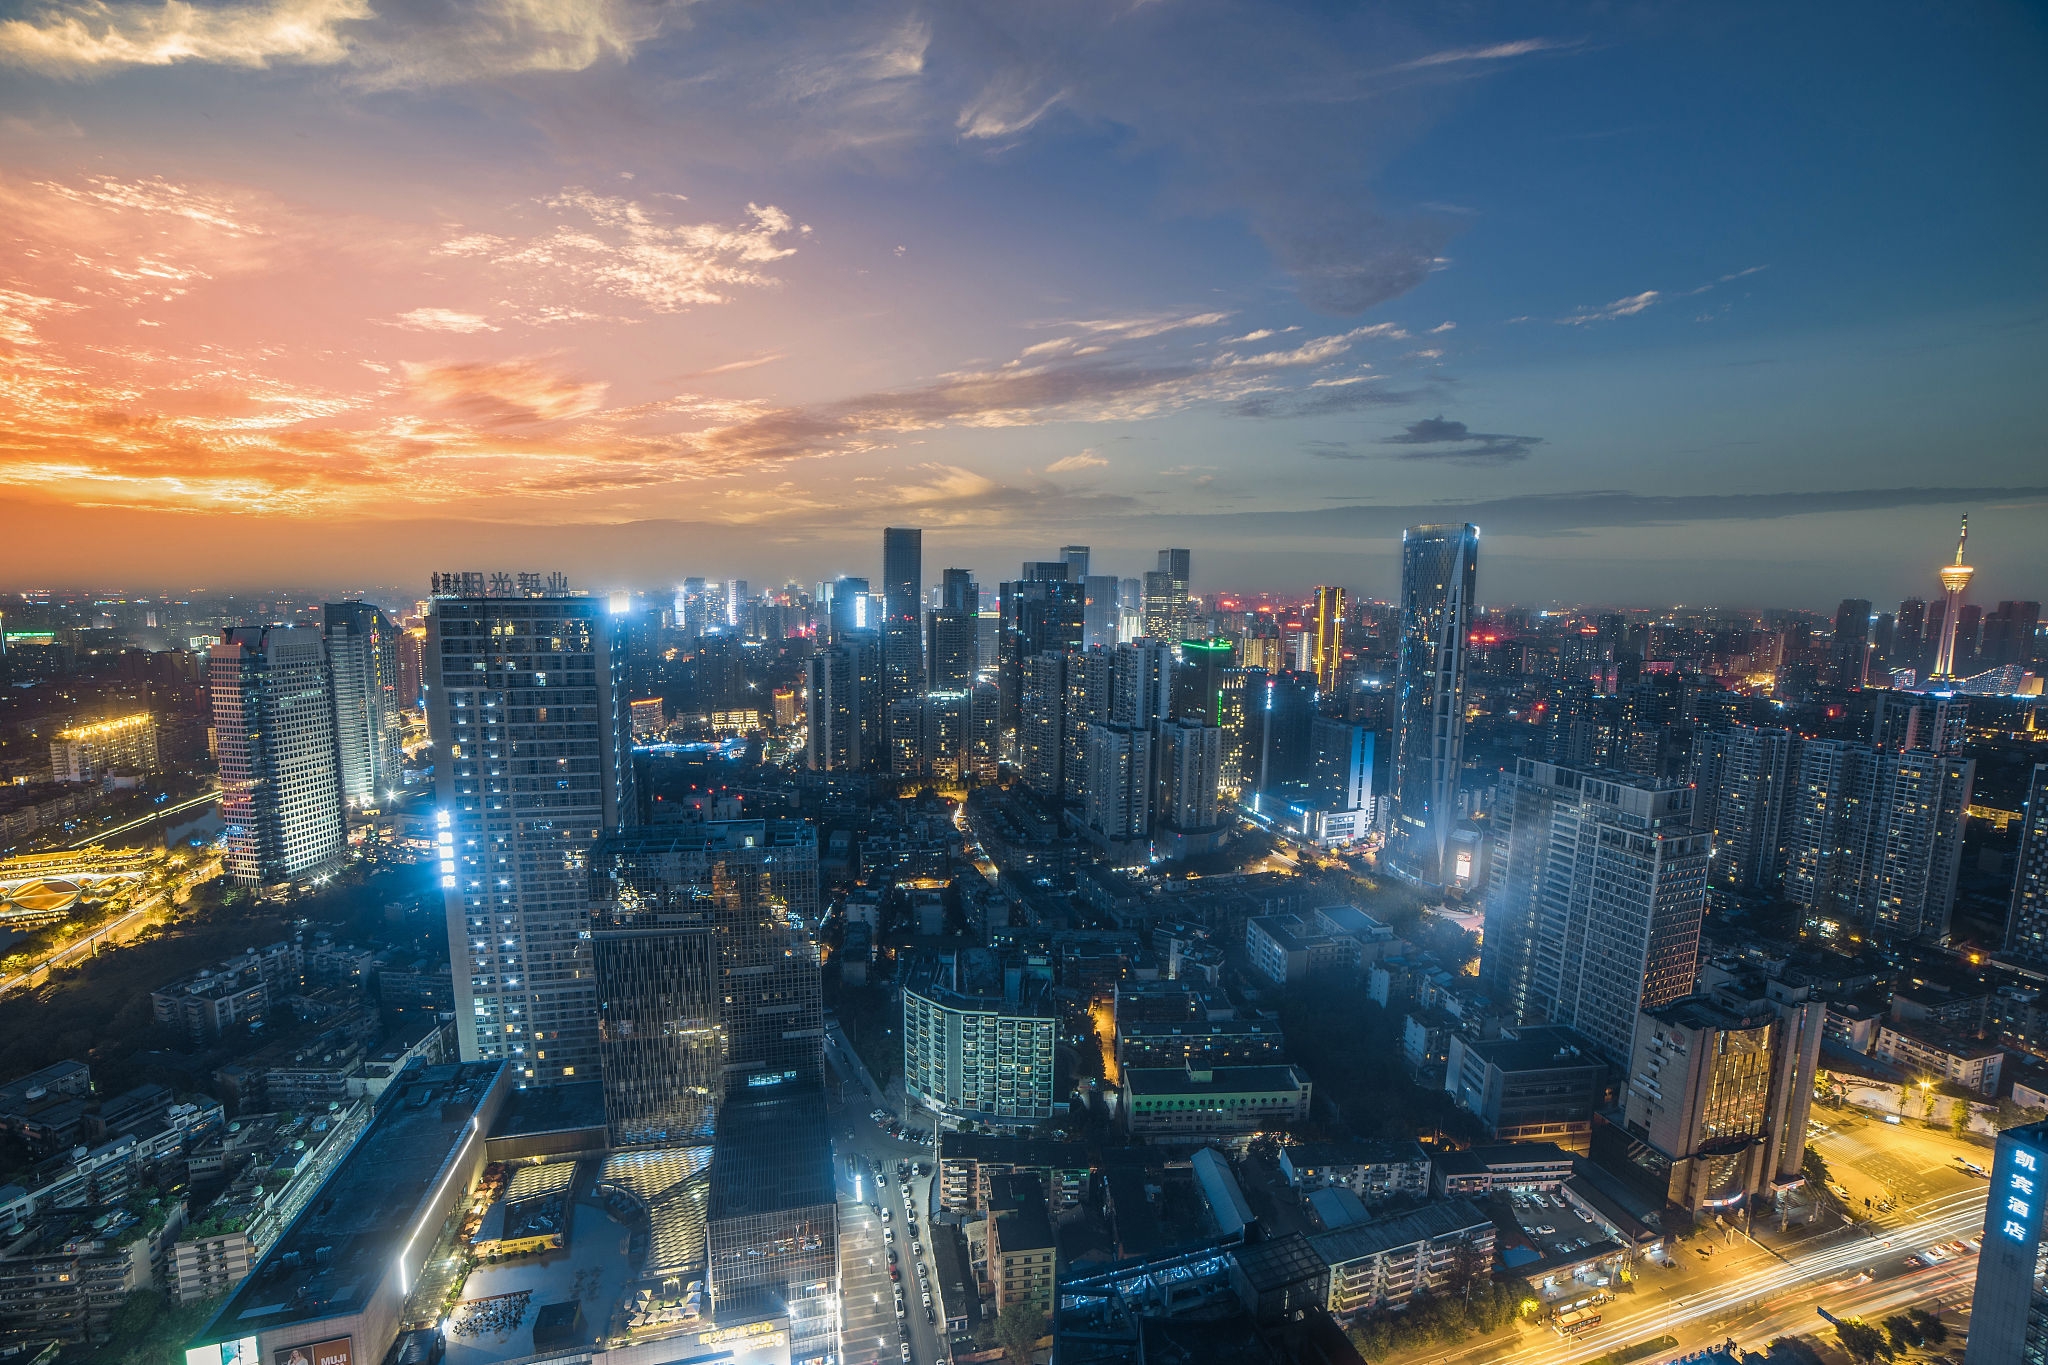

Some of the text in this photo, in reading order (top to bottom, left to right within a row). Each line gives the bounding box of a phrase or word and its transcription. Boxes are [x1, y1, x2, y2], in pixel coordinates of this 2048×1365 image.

[1666, 1041, 1687, 1057] ICBC
[2003, 1149, 2037, 1241] 凯宾酒店
[699, 1322, 773, 1344] 阳光新业中心
[321, 1354, 346, 1365] MUJI
